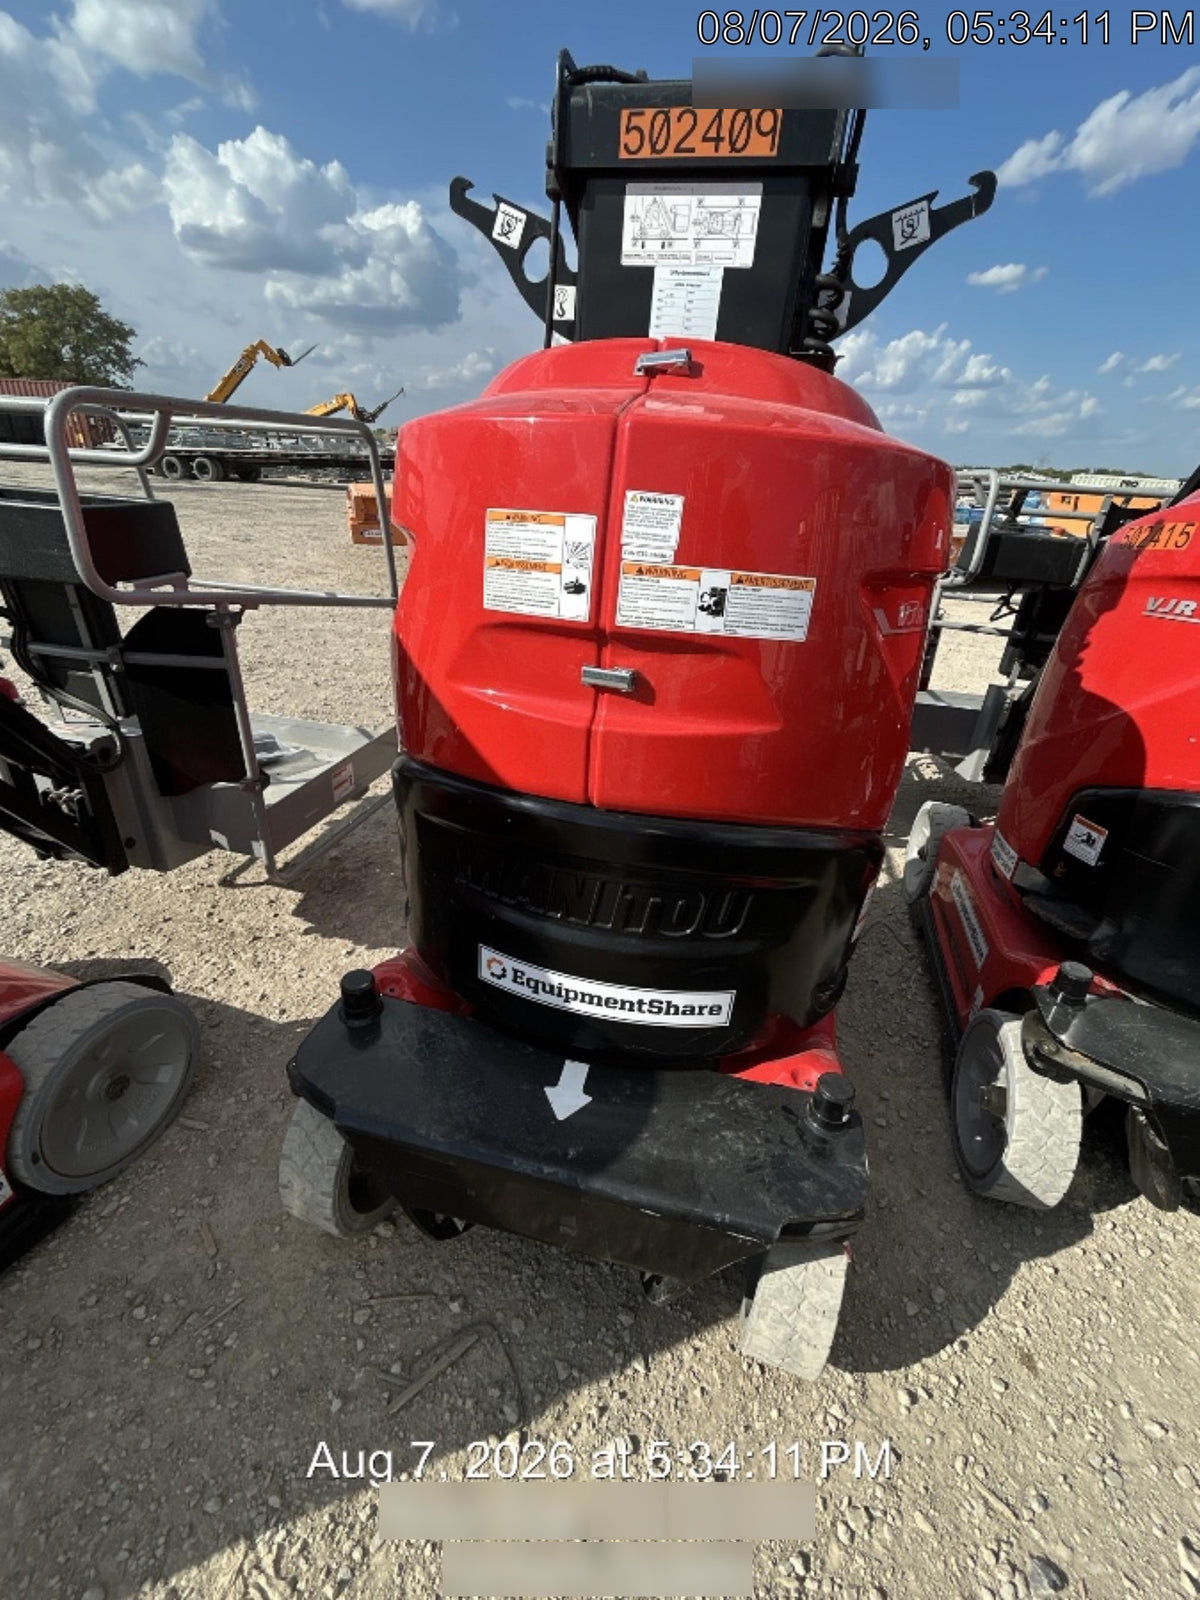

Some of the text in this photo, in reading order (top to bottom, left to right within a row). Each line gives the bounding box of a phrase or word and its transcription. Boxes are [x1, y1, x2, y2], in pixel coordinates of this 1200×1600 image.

[623, 109, 779, 155] 502409
[1122, 522, 1196, 549] 502415
[1145, 597, 1197, 616] VJR
[454, 866, 753, 938] NITOU
[511, 966, 722, 1016] EquipmentShare
